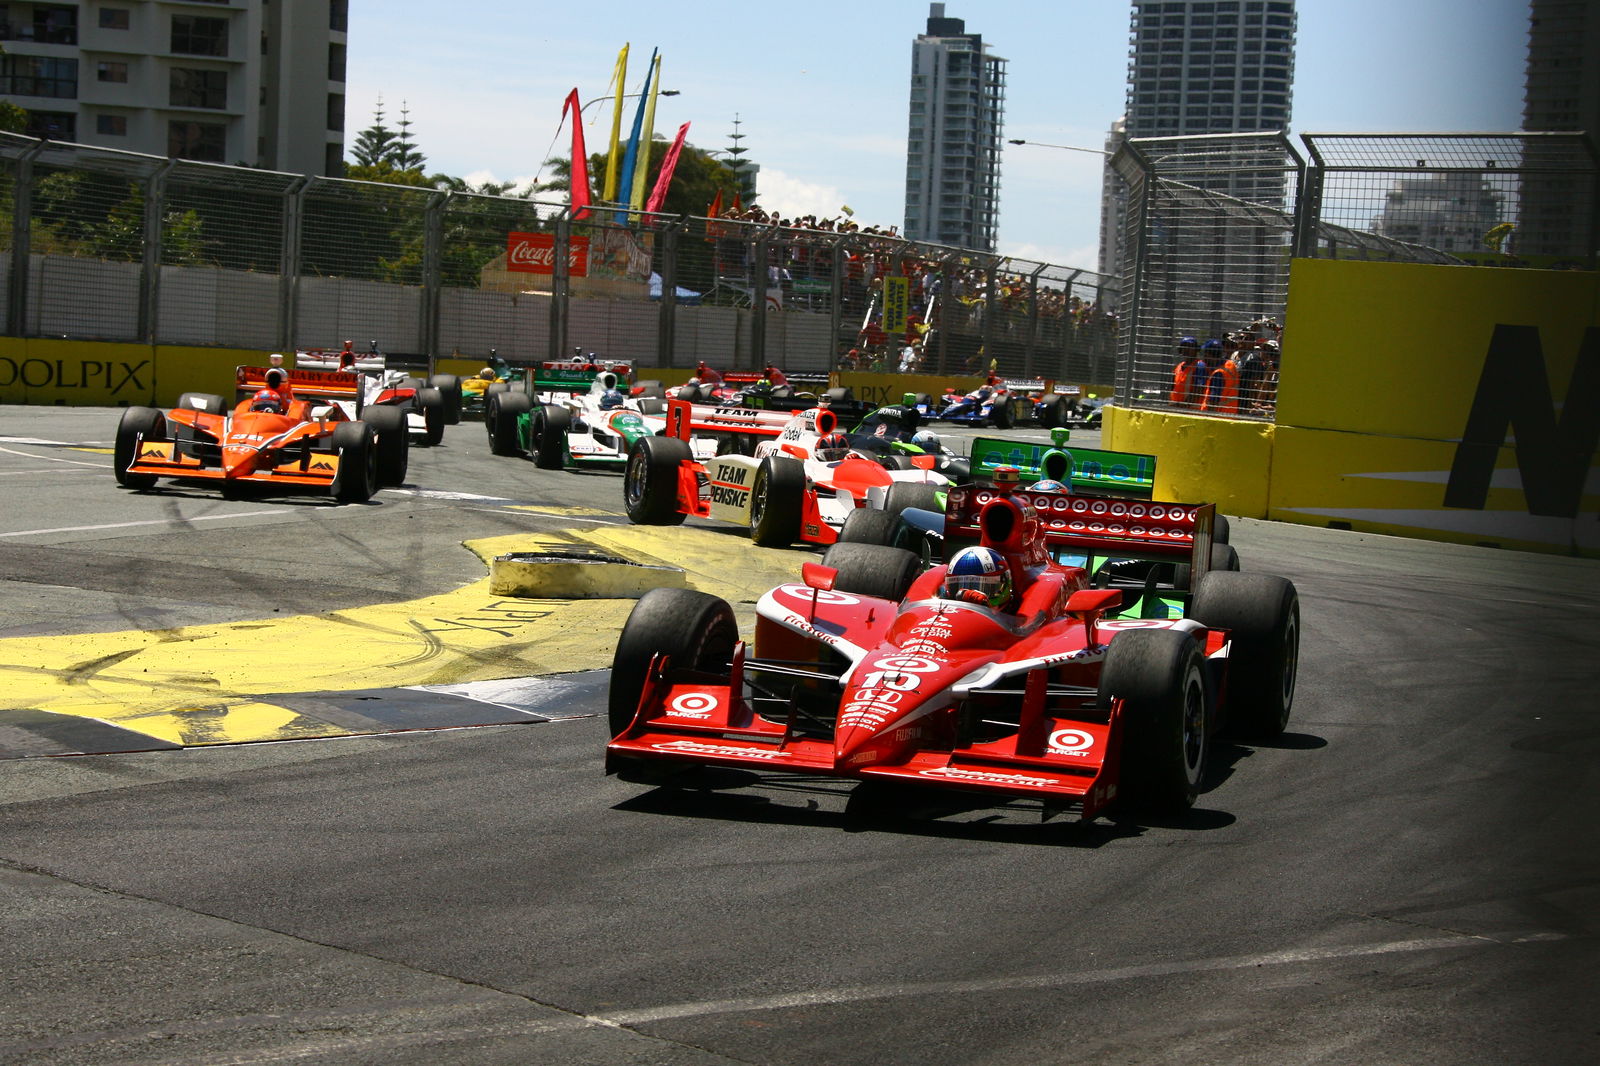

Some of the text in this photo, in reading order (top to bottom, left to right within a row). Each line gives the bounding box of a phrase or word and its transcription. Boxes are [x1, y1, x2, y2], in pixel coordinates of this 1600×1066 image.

[714, 407, 759, 417] TEAM
[717, 464, 747, 485] TEAM
[981, 446, 1147, 484] ethnol
[710, 485, 749, 508] PENSKE
[861, 670, 921, 691] 10
[665, 710, 712, 720] TARGET
